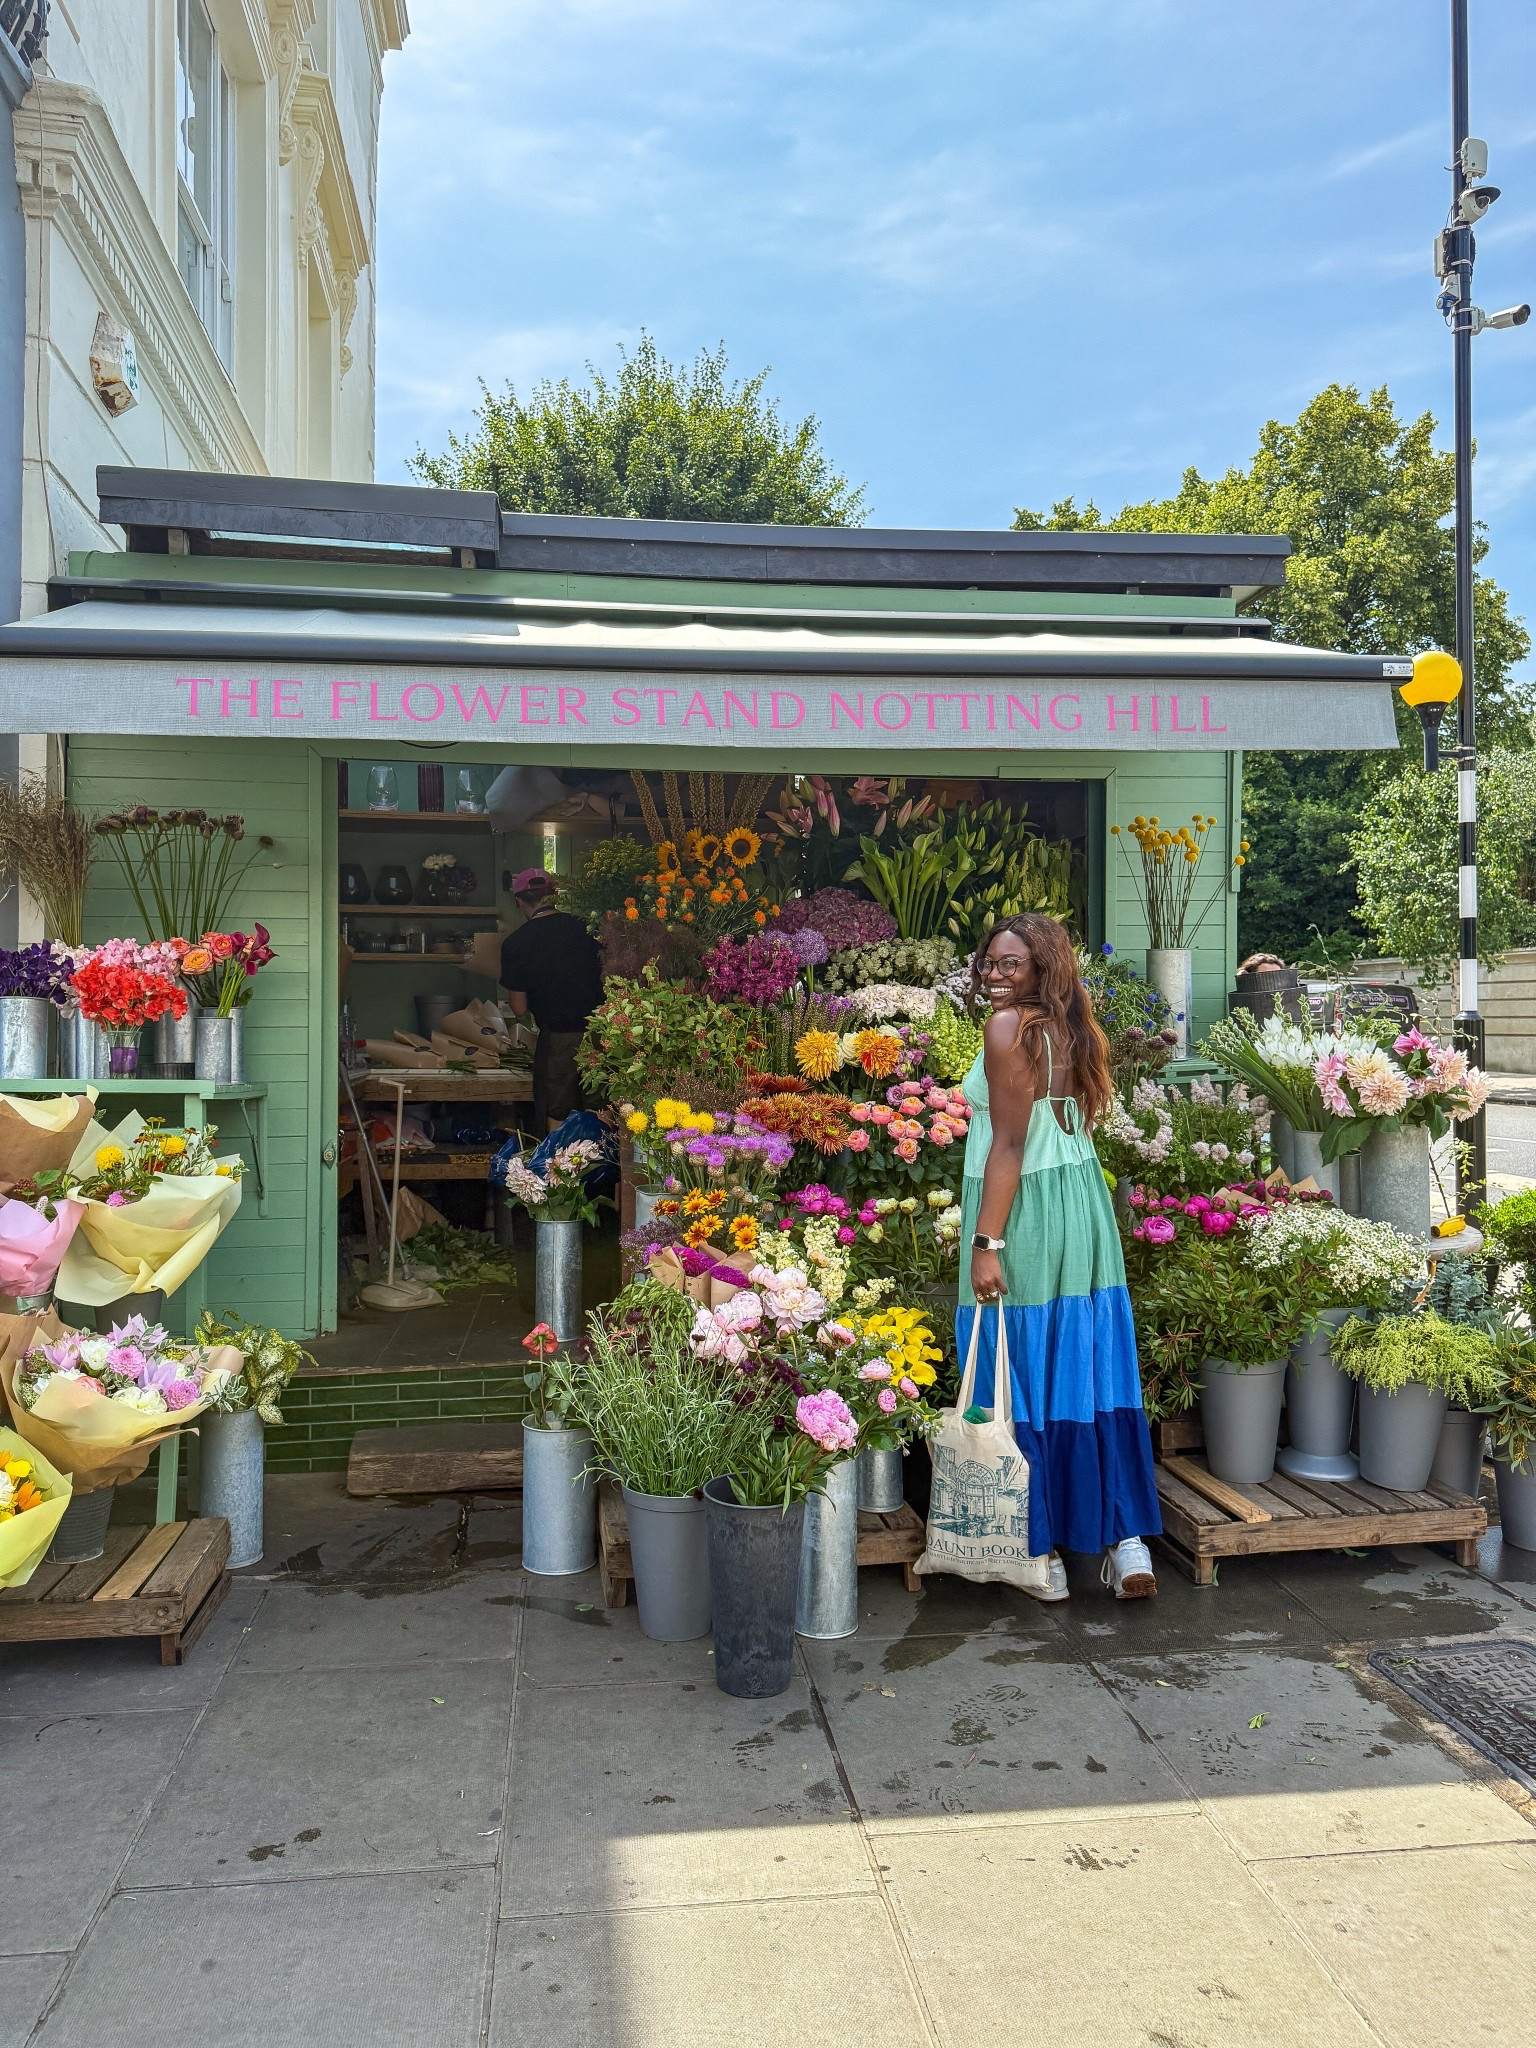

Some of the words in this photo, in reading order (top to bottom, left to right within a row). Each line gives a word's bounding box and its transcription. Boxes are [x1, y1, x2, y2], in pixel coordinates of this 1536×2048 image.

[176, 678, 304, 720] THE
[330, 681, 589, 725] FLOWER
[611, 687, 806, 729] STAND
[829, 692, 1084, 731] NOTTING
[1105, 694, 1229, 732] HILL
[928, 1534, 977, 1557] DAUNT
[981, 1543, 1036, 1559] BOOK
[1002, 1559, 1028, 1568] LONDON
